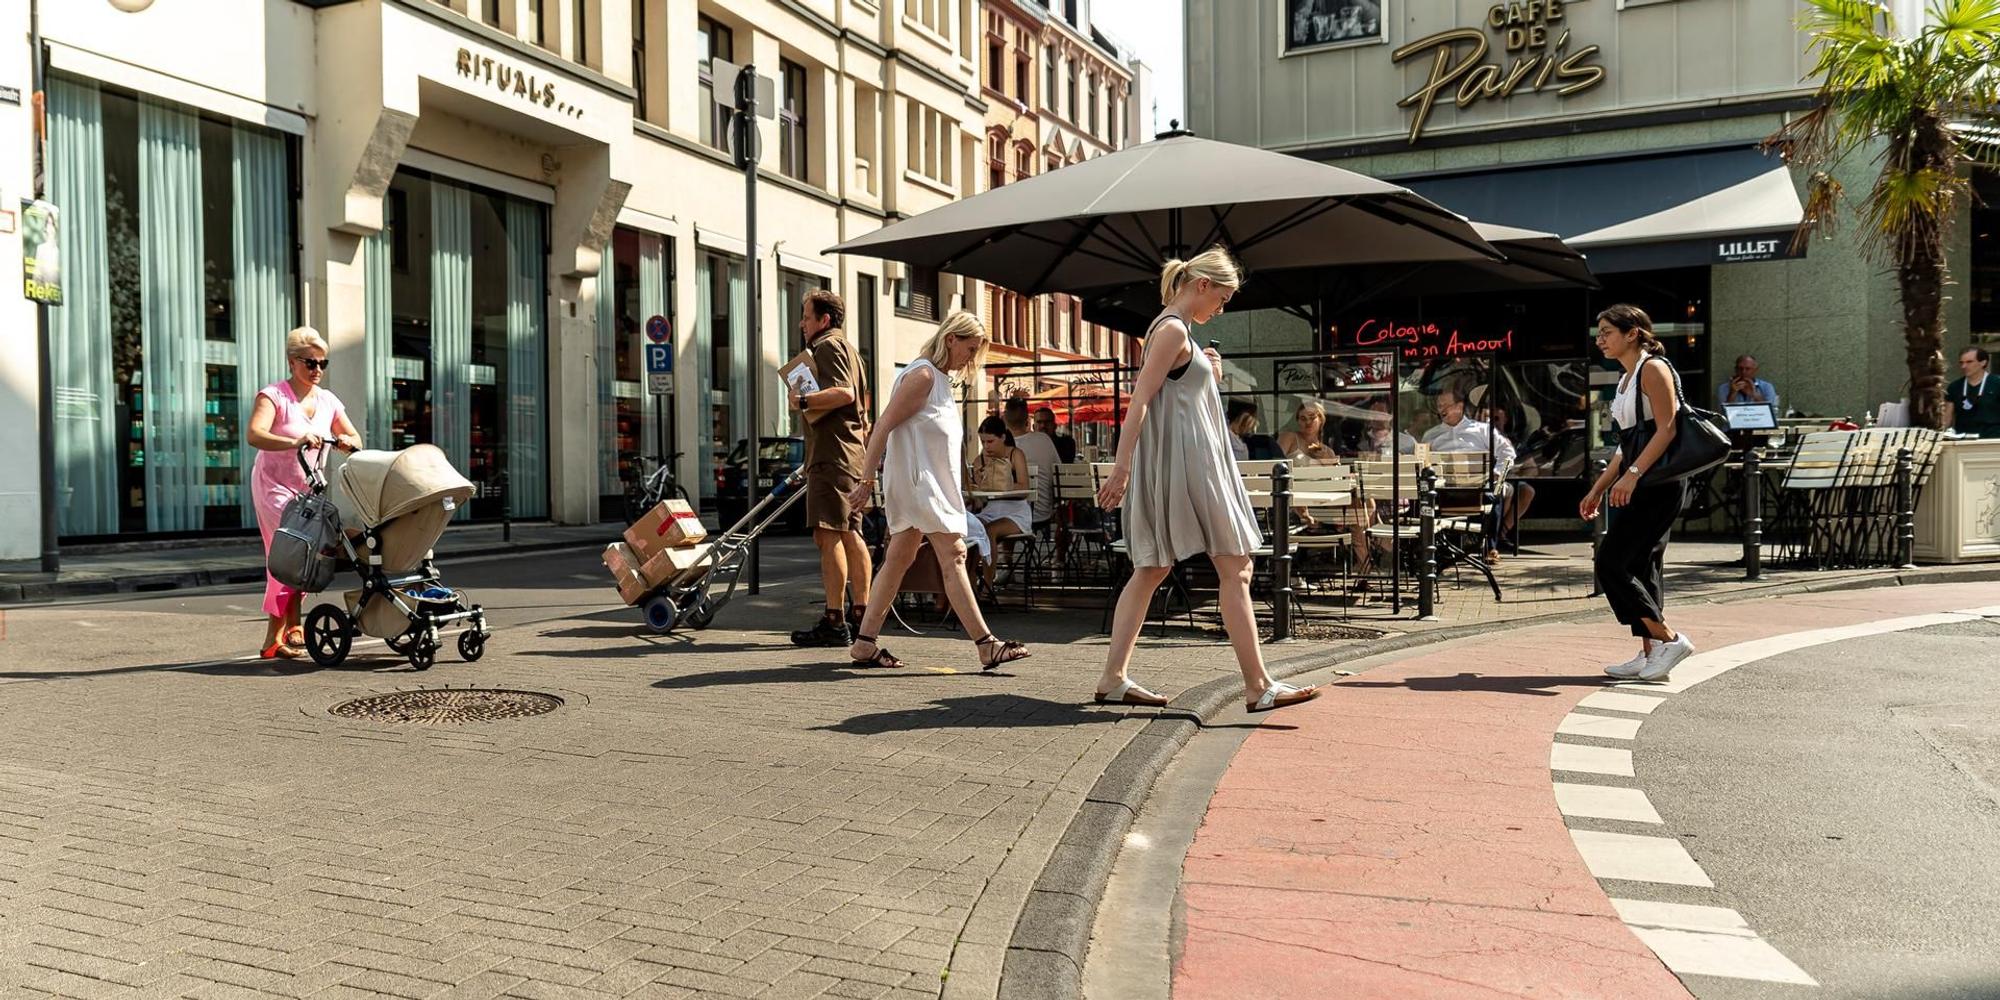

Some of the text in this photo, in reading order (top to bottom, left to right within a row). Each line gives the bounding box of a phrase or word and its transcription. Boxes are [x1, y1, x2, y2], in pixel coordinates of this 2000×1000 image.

[1507, 24, 1546, 50] DE
[1392, 27, 1606, 144] Paris
[1719, 240, 1780, 256] LILLET
[652, 347, 666, 369] P
